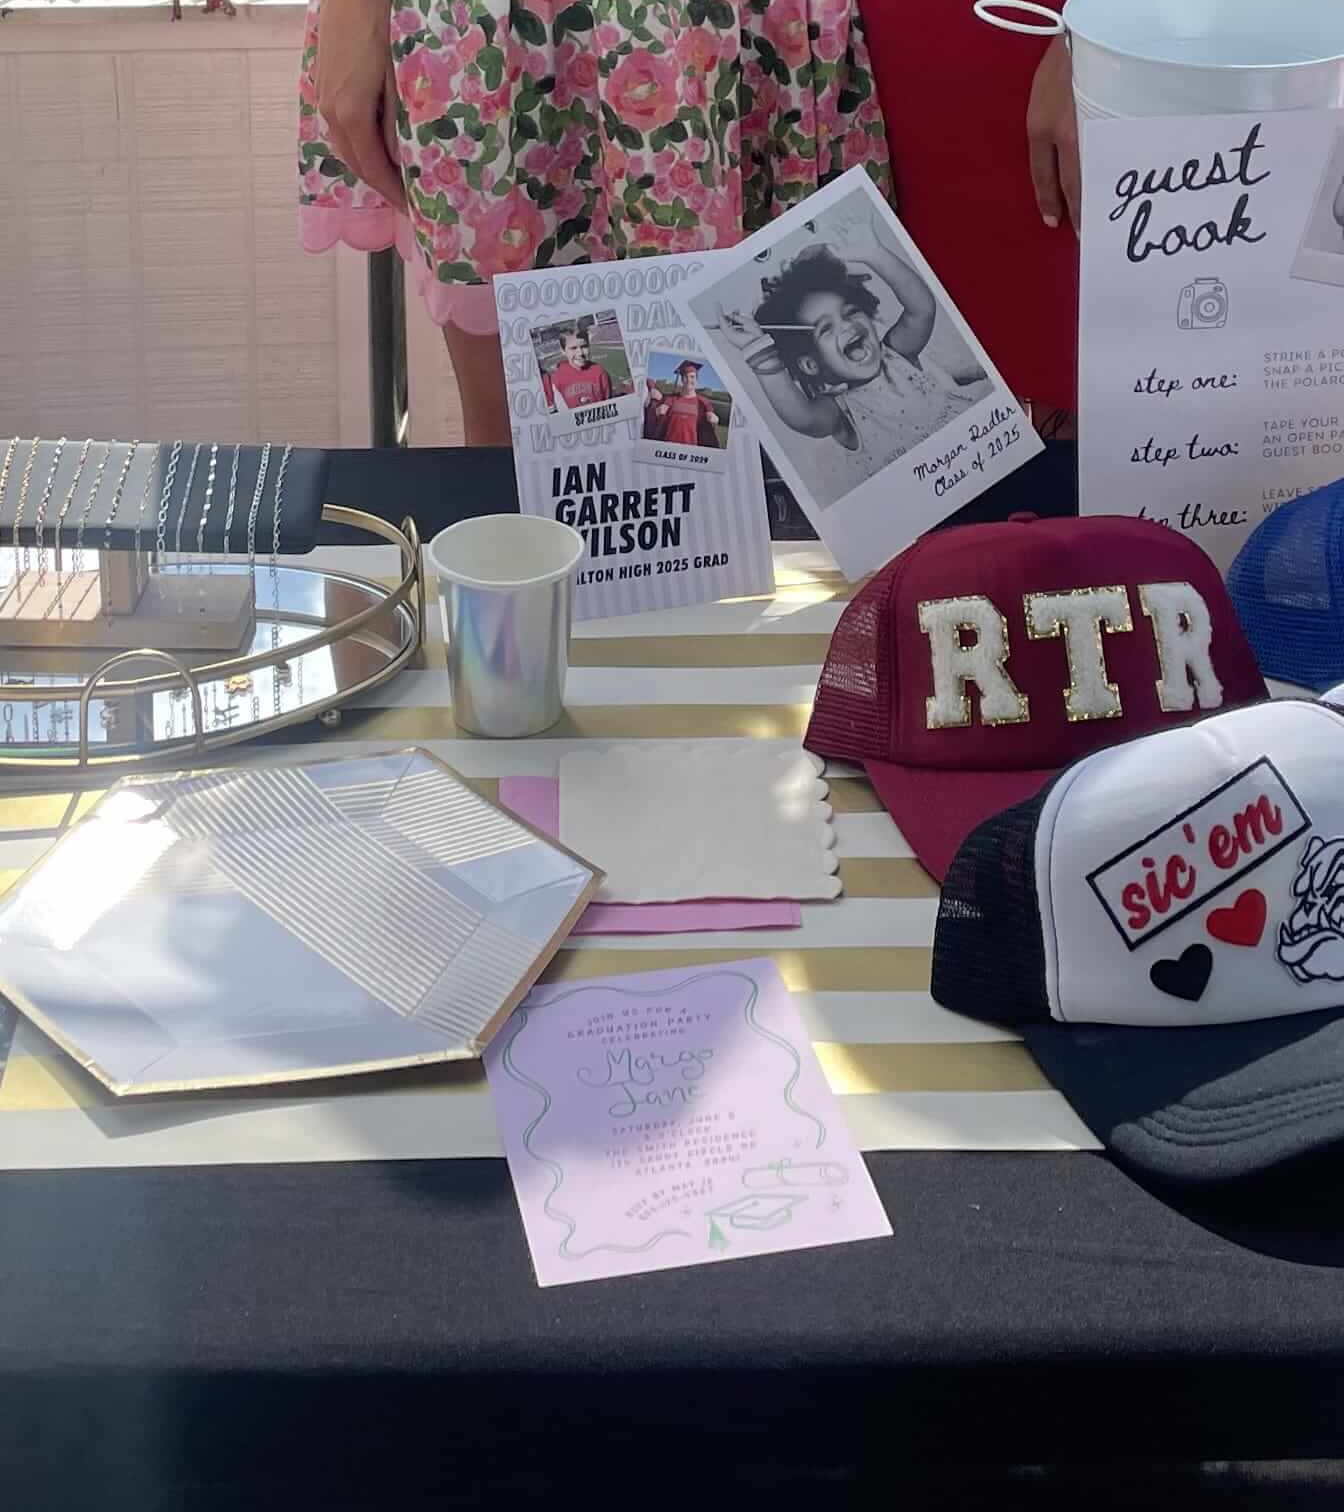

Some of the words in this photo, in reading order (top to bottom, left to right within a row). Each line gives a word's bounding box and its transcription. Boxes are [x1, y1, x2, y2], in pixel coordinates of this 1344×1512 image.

[1108, 122, 1271, 222] guest
[1126, 193, 1266, 263] book
[1263, 351, 1312, 364] STRIKE
[1317, 351, 1327, 360] A
[1263, 365, 1299, 377] SNAP
[1304, 363, 1314, 374] A
[1133, 367, 1183, 399] step
[1191, 374, 1238, 391] one:
[1263, 379, 1289, 390] THE
[1262, 434, 1281, 445] AN
[1287, 431, 1325, 443] OPEN
[1263, 419, 1295, 431] TAPE
[1301, 416, 1339, 429] YOUR
[913, 444, 967, 481] Morgan
[934, 469, 969, 496] Class
[972, 452, 985, 472] of
[988, 424, 1020, 458] 2025
[1129, 437, 1180, 467] step
[1187, 438, 1239, 460] two:
[1262, 446, 1307, 459] GUEST
[552, 462, 606, 498] IAN
[1262, 487, 1303, 500] LEAVE
[556, 483, 695, 527] GARRETT
[1177, 503, 1248, 530] three:
[583, 517, 681, 558] ILSON
[619, 561, 652, 579] HIGH
[656, 557, 689, 574] 2025
[694, 553, 729, 569] GRAD
[917, 581, 1224, 730] RTR
[667, 1013, 712, 1027] PARTY
[608, 1082, 701, 1118] Jane
